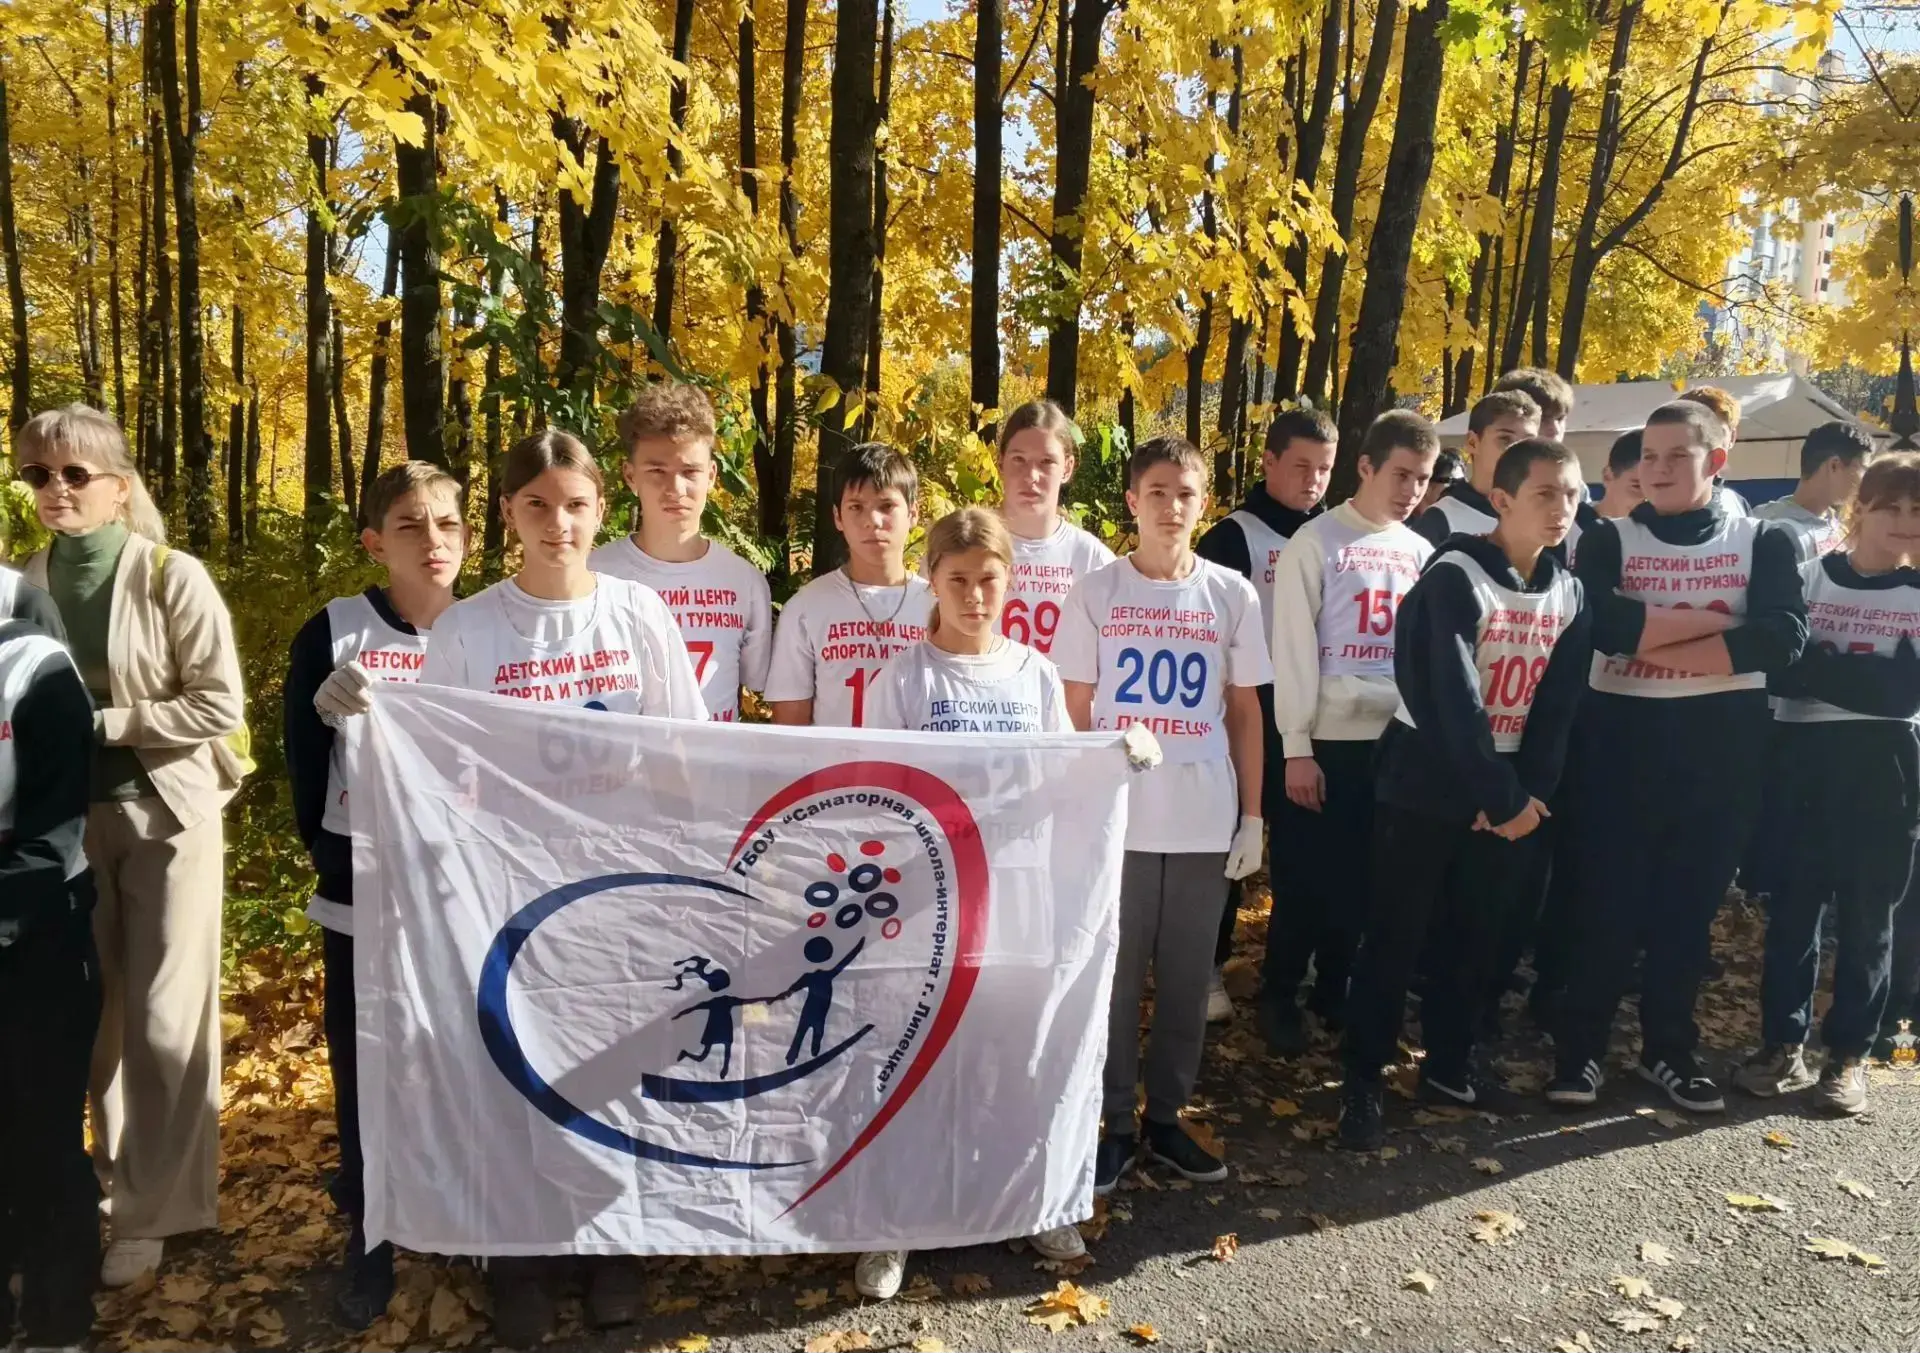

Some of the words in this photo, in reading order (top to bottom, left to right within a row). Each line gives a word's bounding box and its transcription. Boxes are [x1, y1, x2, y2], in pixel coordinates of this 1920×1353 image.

[1035, 565, 1074, 578] ЦЕНТР
[1625, 555, 1689, 572] ДЕТСКИЙ
[1694, 554, 1739, 571] ЦЕНТР
[1030, 581, 1071, 594] ТУРИЗ
[1672, 579, 1680, 592] И
[1686, 574, 1747, 590] ТУРИЗМА
[694, 589, 737, 607] ЦЕНТР
[1111, 606, 1171, 621] ДЕТСКИЙ
[1174, 610, 1215, 624] ЦЕНТР
[1354, 588, 1404, 636] 15
[828, 621, 896, 642] ДЕТСКИЙ
[899, 623, 928, 641] ЦЕН
[1101, 623, 1152, 637] СПОРТА
[1155, 627, 1163, 637] И
[360, 651, 425, 670] ДЕТСКИ
[821, 643, 876, 661] СПОРТА
[880, 645, 889, 659] И
[495, 653, 576, 684] ДЕТСКИЙ
[580, 650, 629, 673] ЦЕНТР
[560, 682, 571, 699] И
[574, 673, 639, 697] ТУРИЗМА
[1115, 647, 1207, 708] 209
[1485, 655, 1547, 707] 108
[930, 700, 998, 718] ДЕТСКИЙ
[921, 982, 936, 997] г.
